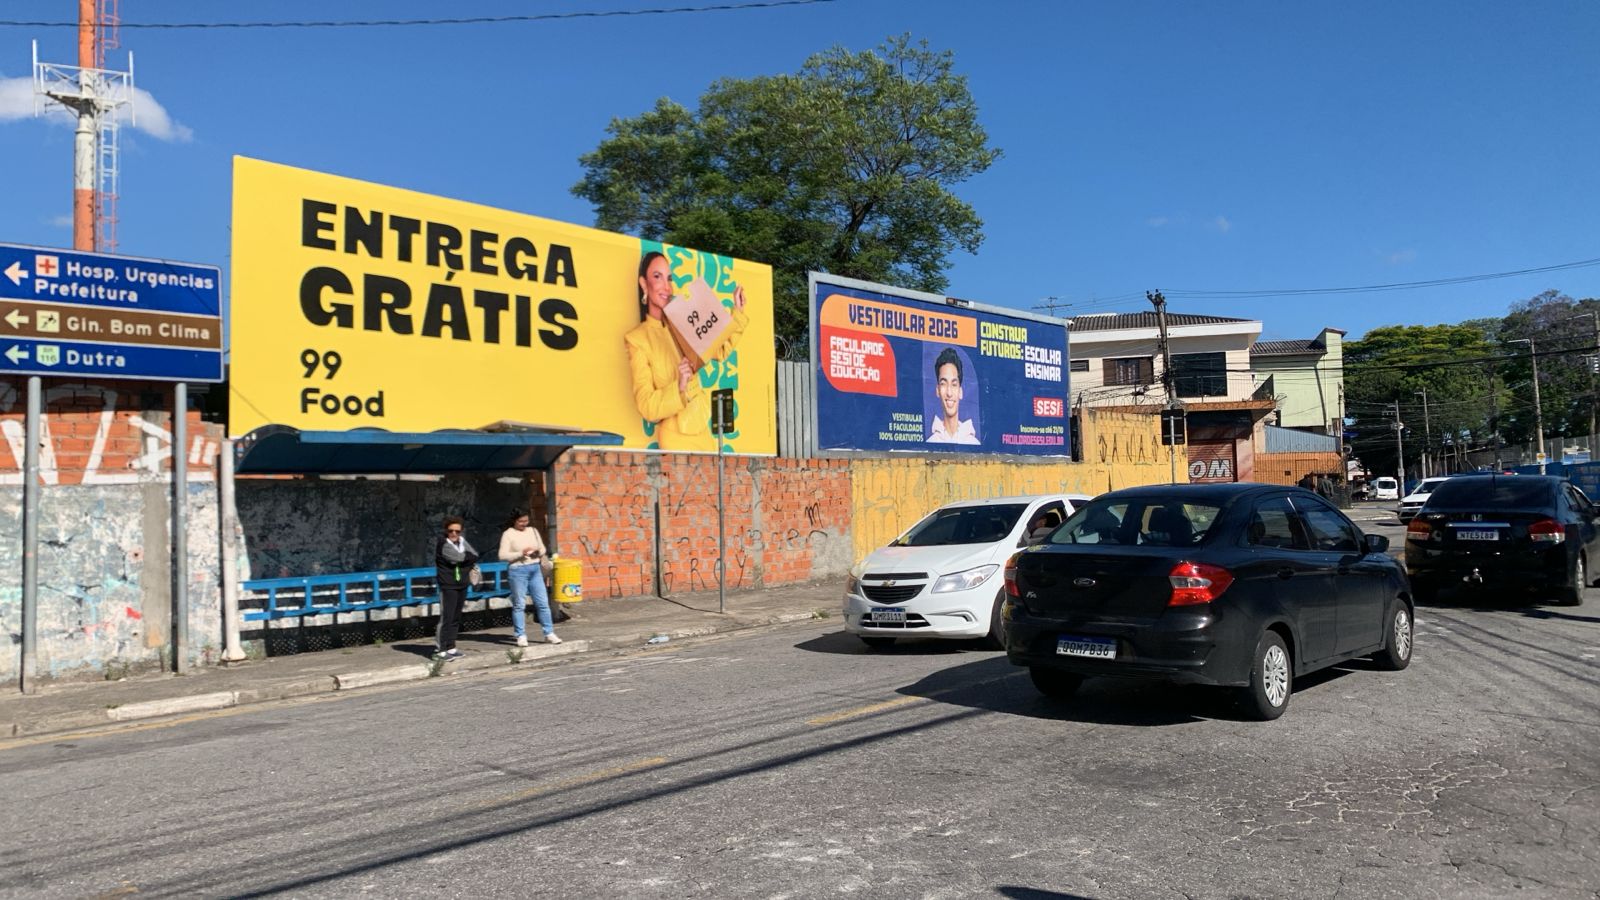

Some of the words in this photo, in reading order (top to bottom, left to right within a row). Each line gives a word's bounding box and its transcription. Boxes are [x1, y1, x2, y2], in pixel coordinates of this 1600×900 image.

[302, 198, 578, 288] ENTREGA
[66, 261, 119, 282] Hosp.
[126, 267, 214, 290] Urgencias
[35, 278, 138, 302] Prefeitura
[300, 266, 579, 351] GRÁTIS
[687, 310, 700, 327] 99
[67, 316, 103, 333] Gin.
[110, 319, 152, 337] Bom
[158, 323, 210, 340] Clima
[695, 311, 718, 340] Food
[849, 303, 925, 335] VESTIBULAR
[929, 317, 958, 340] 2026
[980, 321, 1028, 344] CONSTRUA
[830, 335, 885, 357] FACULDADE
[980, 339, 1024, 360] FUTUROS:
[1025, 345, 1062, 366] ESCOLHA
[66, 350, 126, 367] Dutra
[300, 348, 342, 380] 99
[830, 350, 852, 366] SESI
[853, 353, 866, 368] DE
[830, 364, 880, 382] EDUCAÇÃO
[1025, 363, 1061, 382] ENSINAR
[300, 387, 385, 417] Food
[1036, 400, 1061, 416] SESI
[892, 412, 923, 423] VESTIBULAR
[894, 423, 923, 432] FACULDADE
[879, 432, 893, 441] 100%
[894, 433, 924, 442] GRATUITOS
